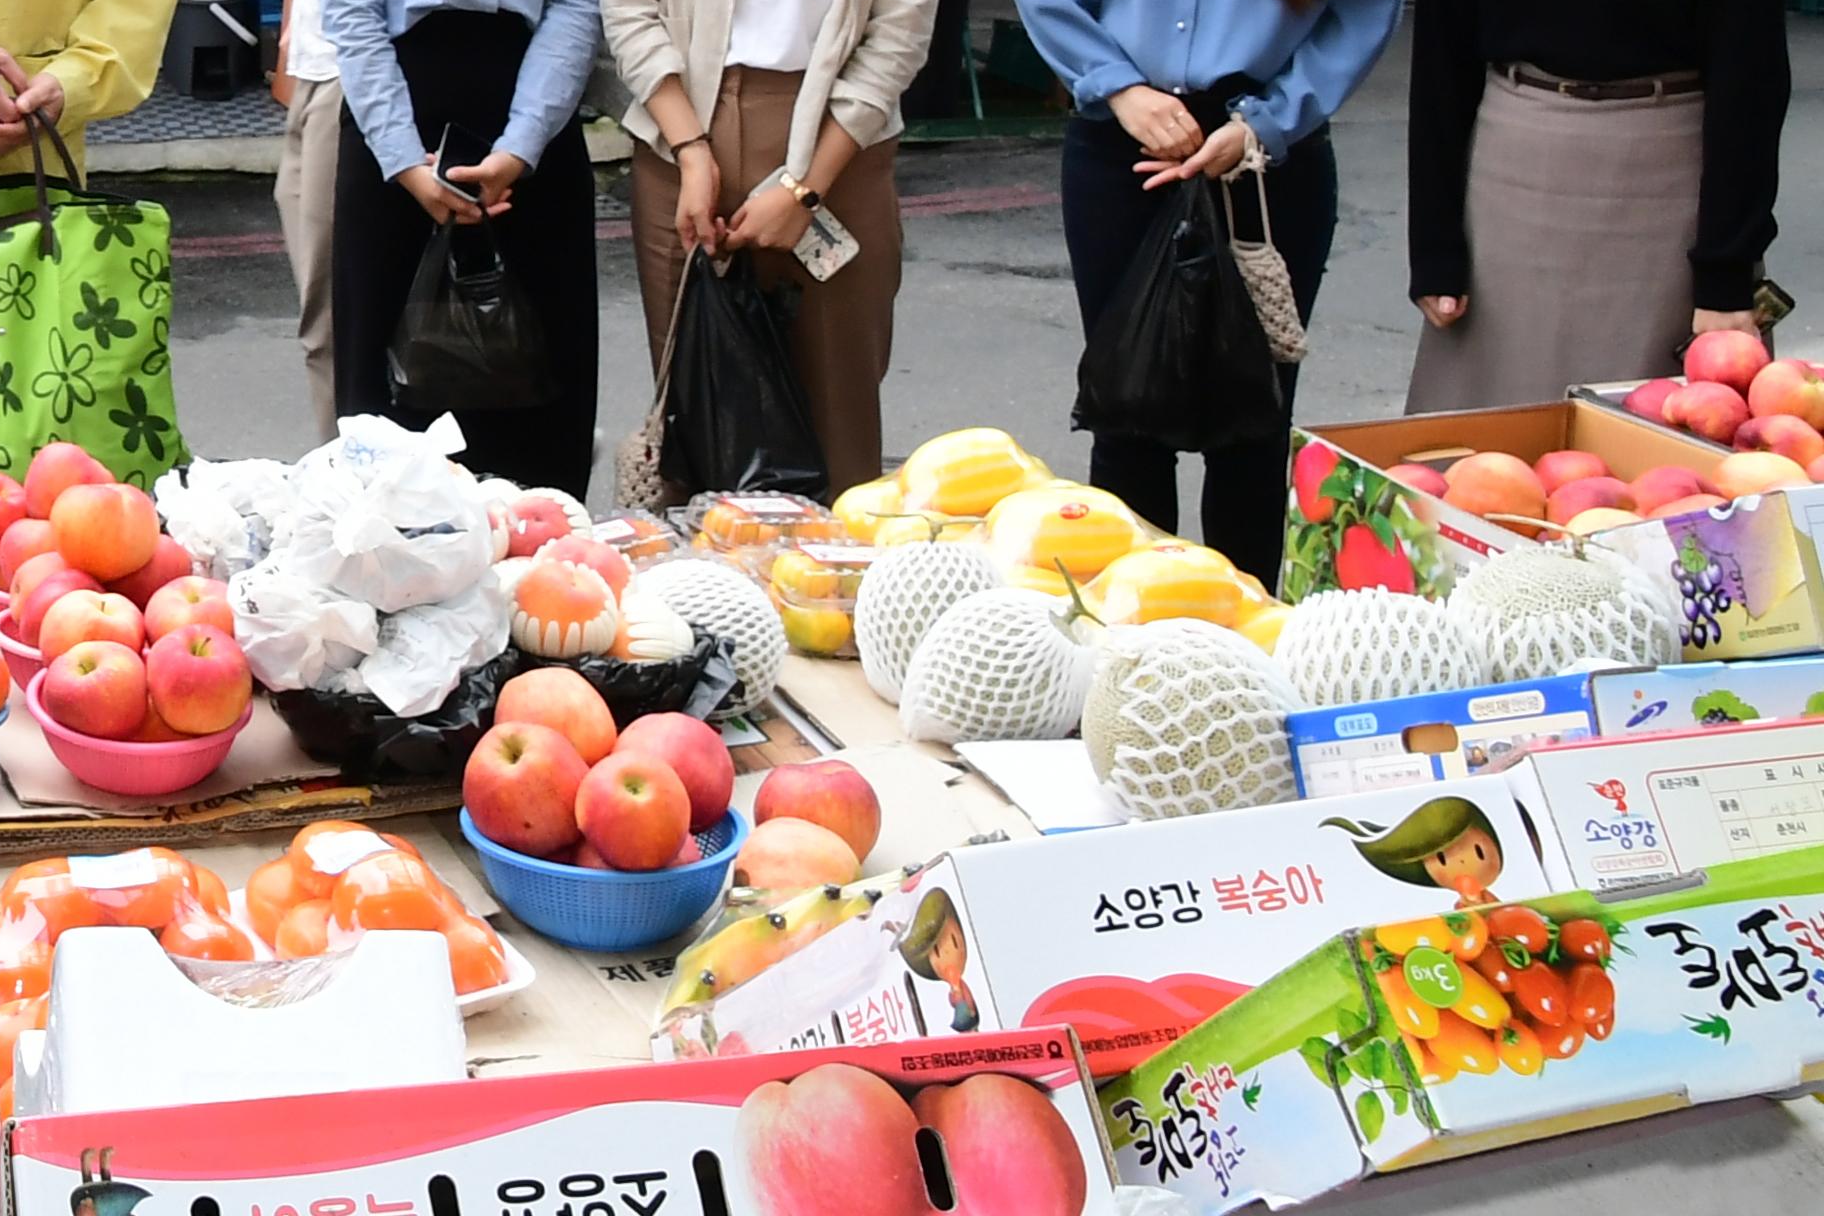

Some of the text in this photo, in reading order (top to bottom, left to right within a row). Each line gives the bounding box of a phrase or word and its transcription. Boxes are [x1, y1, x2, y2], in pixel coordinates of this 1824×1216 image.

[1584, 818, 1658, 851] 소양강
[1092, 864, 1325, 934] 소양강 복숭아
